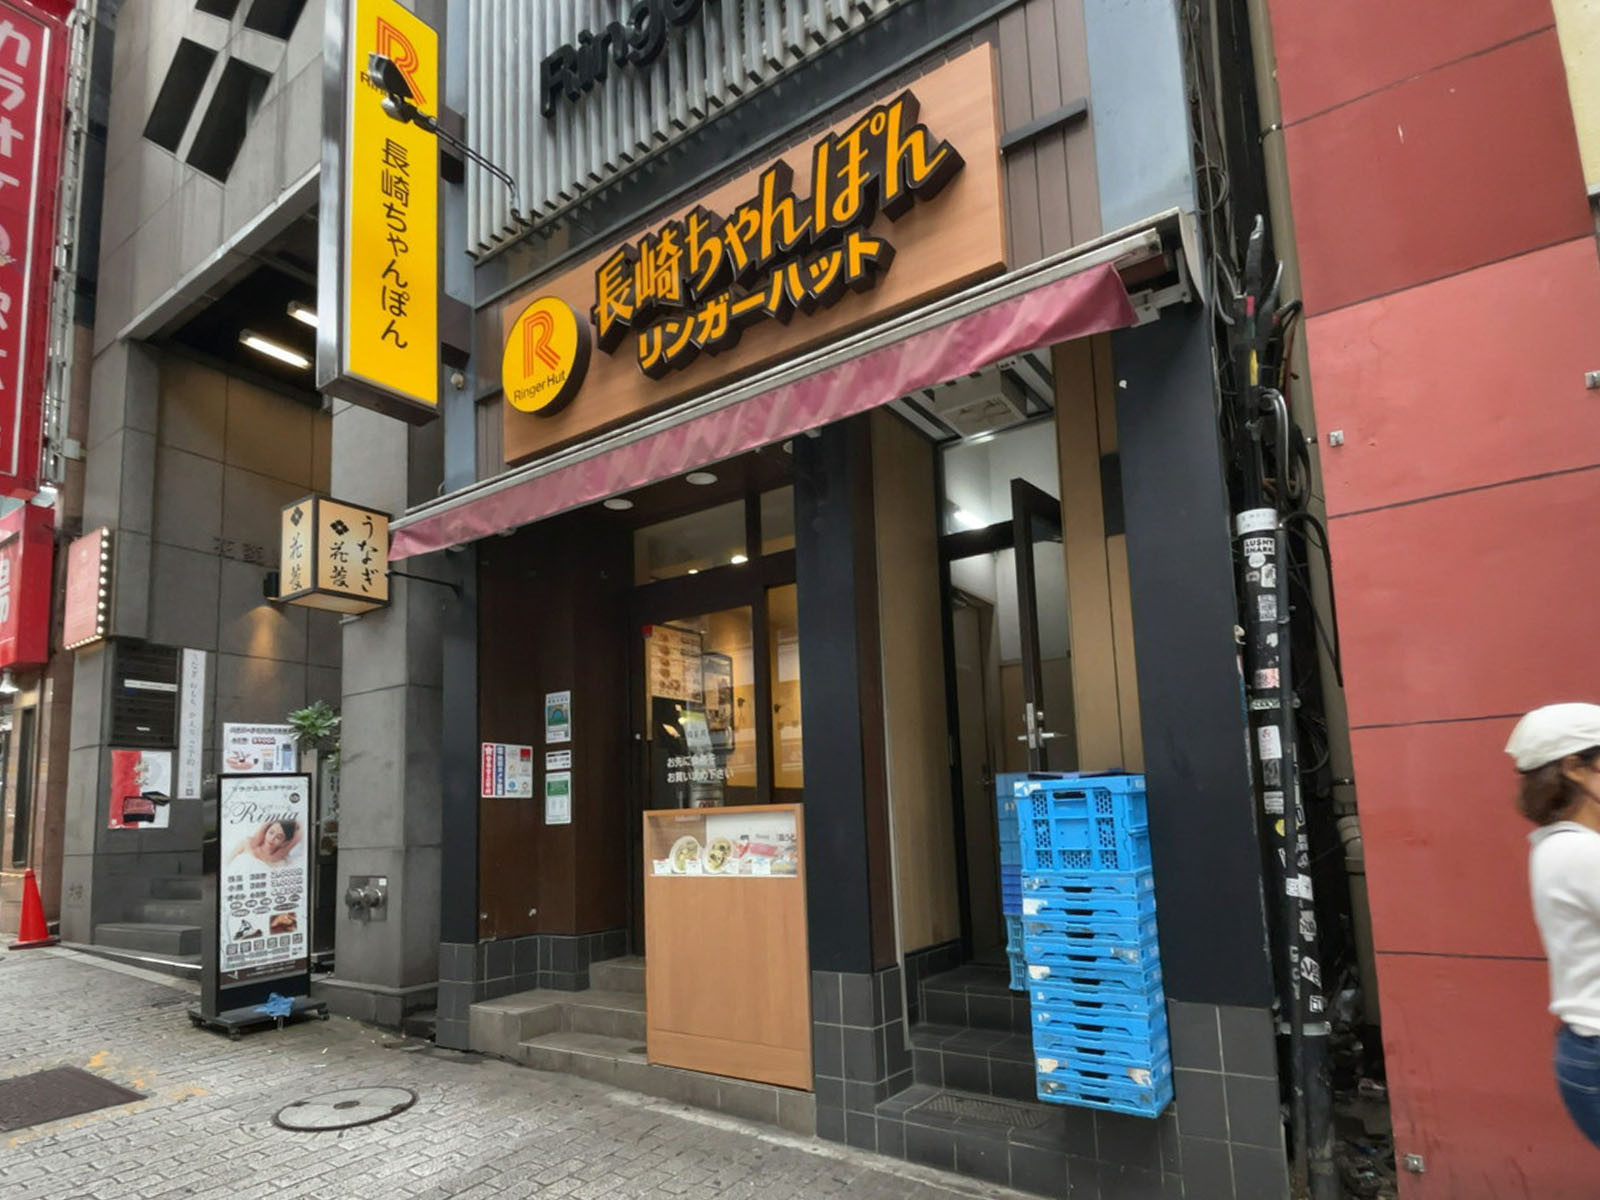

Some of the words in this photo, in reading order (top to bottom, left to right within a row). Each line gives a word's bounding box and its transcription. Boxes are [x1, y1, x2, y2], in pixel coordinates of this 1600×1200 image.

[380, 137, 411, 350] 長崎ちゃんぽん
[593, 95, 955, 345] 長崎ちゃんぽん
[637, 231, 884, 371] リンガーハット
[513, 380, 546, 403] Ringer
[547, 370, 566, 388] Hut
[357, 515, 380, 592] うなぎ
